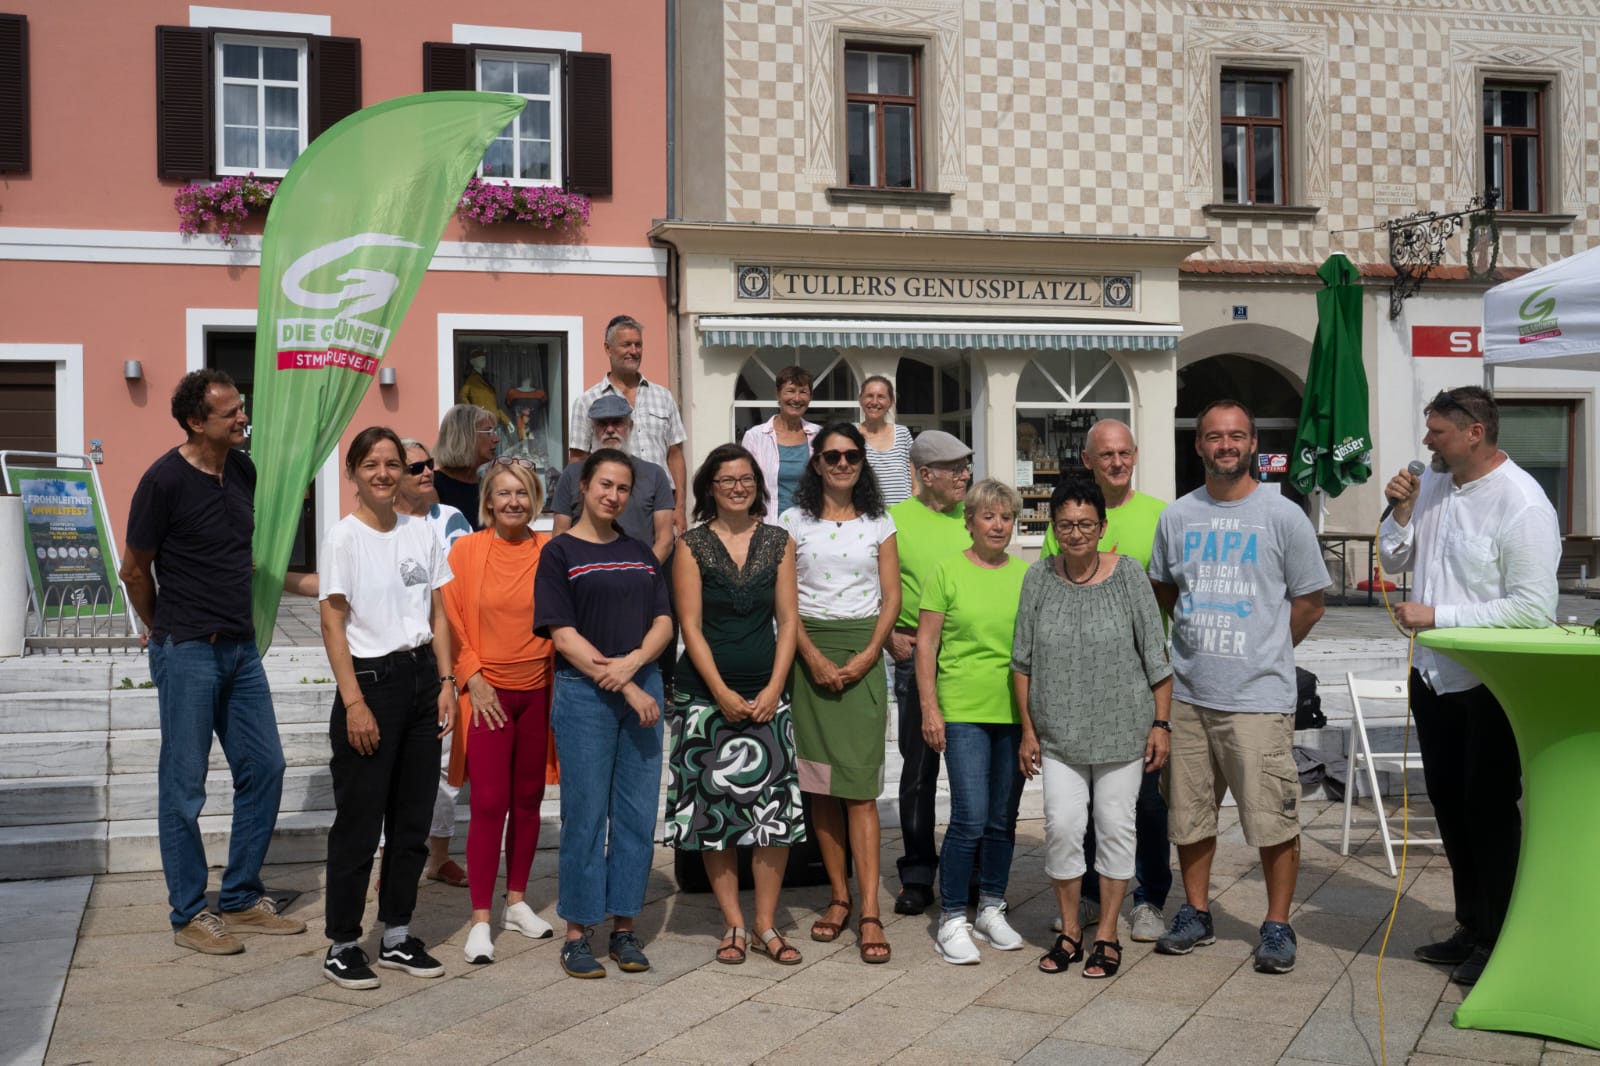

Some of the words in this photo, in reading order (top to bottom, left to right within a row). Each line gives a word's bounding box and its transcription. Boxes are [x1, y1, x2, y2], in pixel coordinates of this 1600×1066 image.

[783, 273, 897, 297] TULLERS
[903, 277, 1092, 301] GENUSSPLATZL
[282, 323, 317, 342] DIE
[28, 494, 93, 505] FROHNLEITNER
[1210, 517, 1240, 530] WENN
[1183, 531, 1258, 565] PAPA
[1190, 613, 1214, 627] KANN
[1216, 615, 1231, 628] ES
